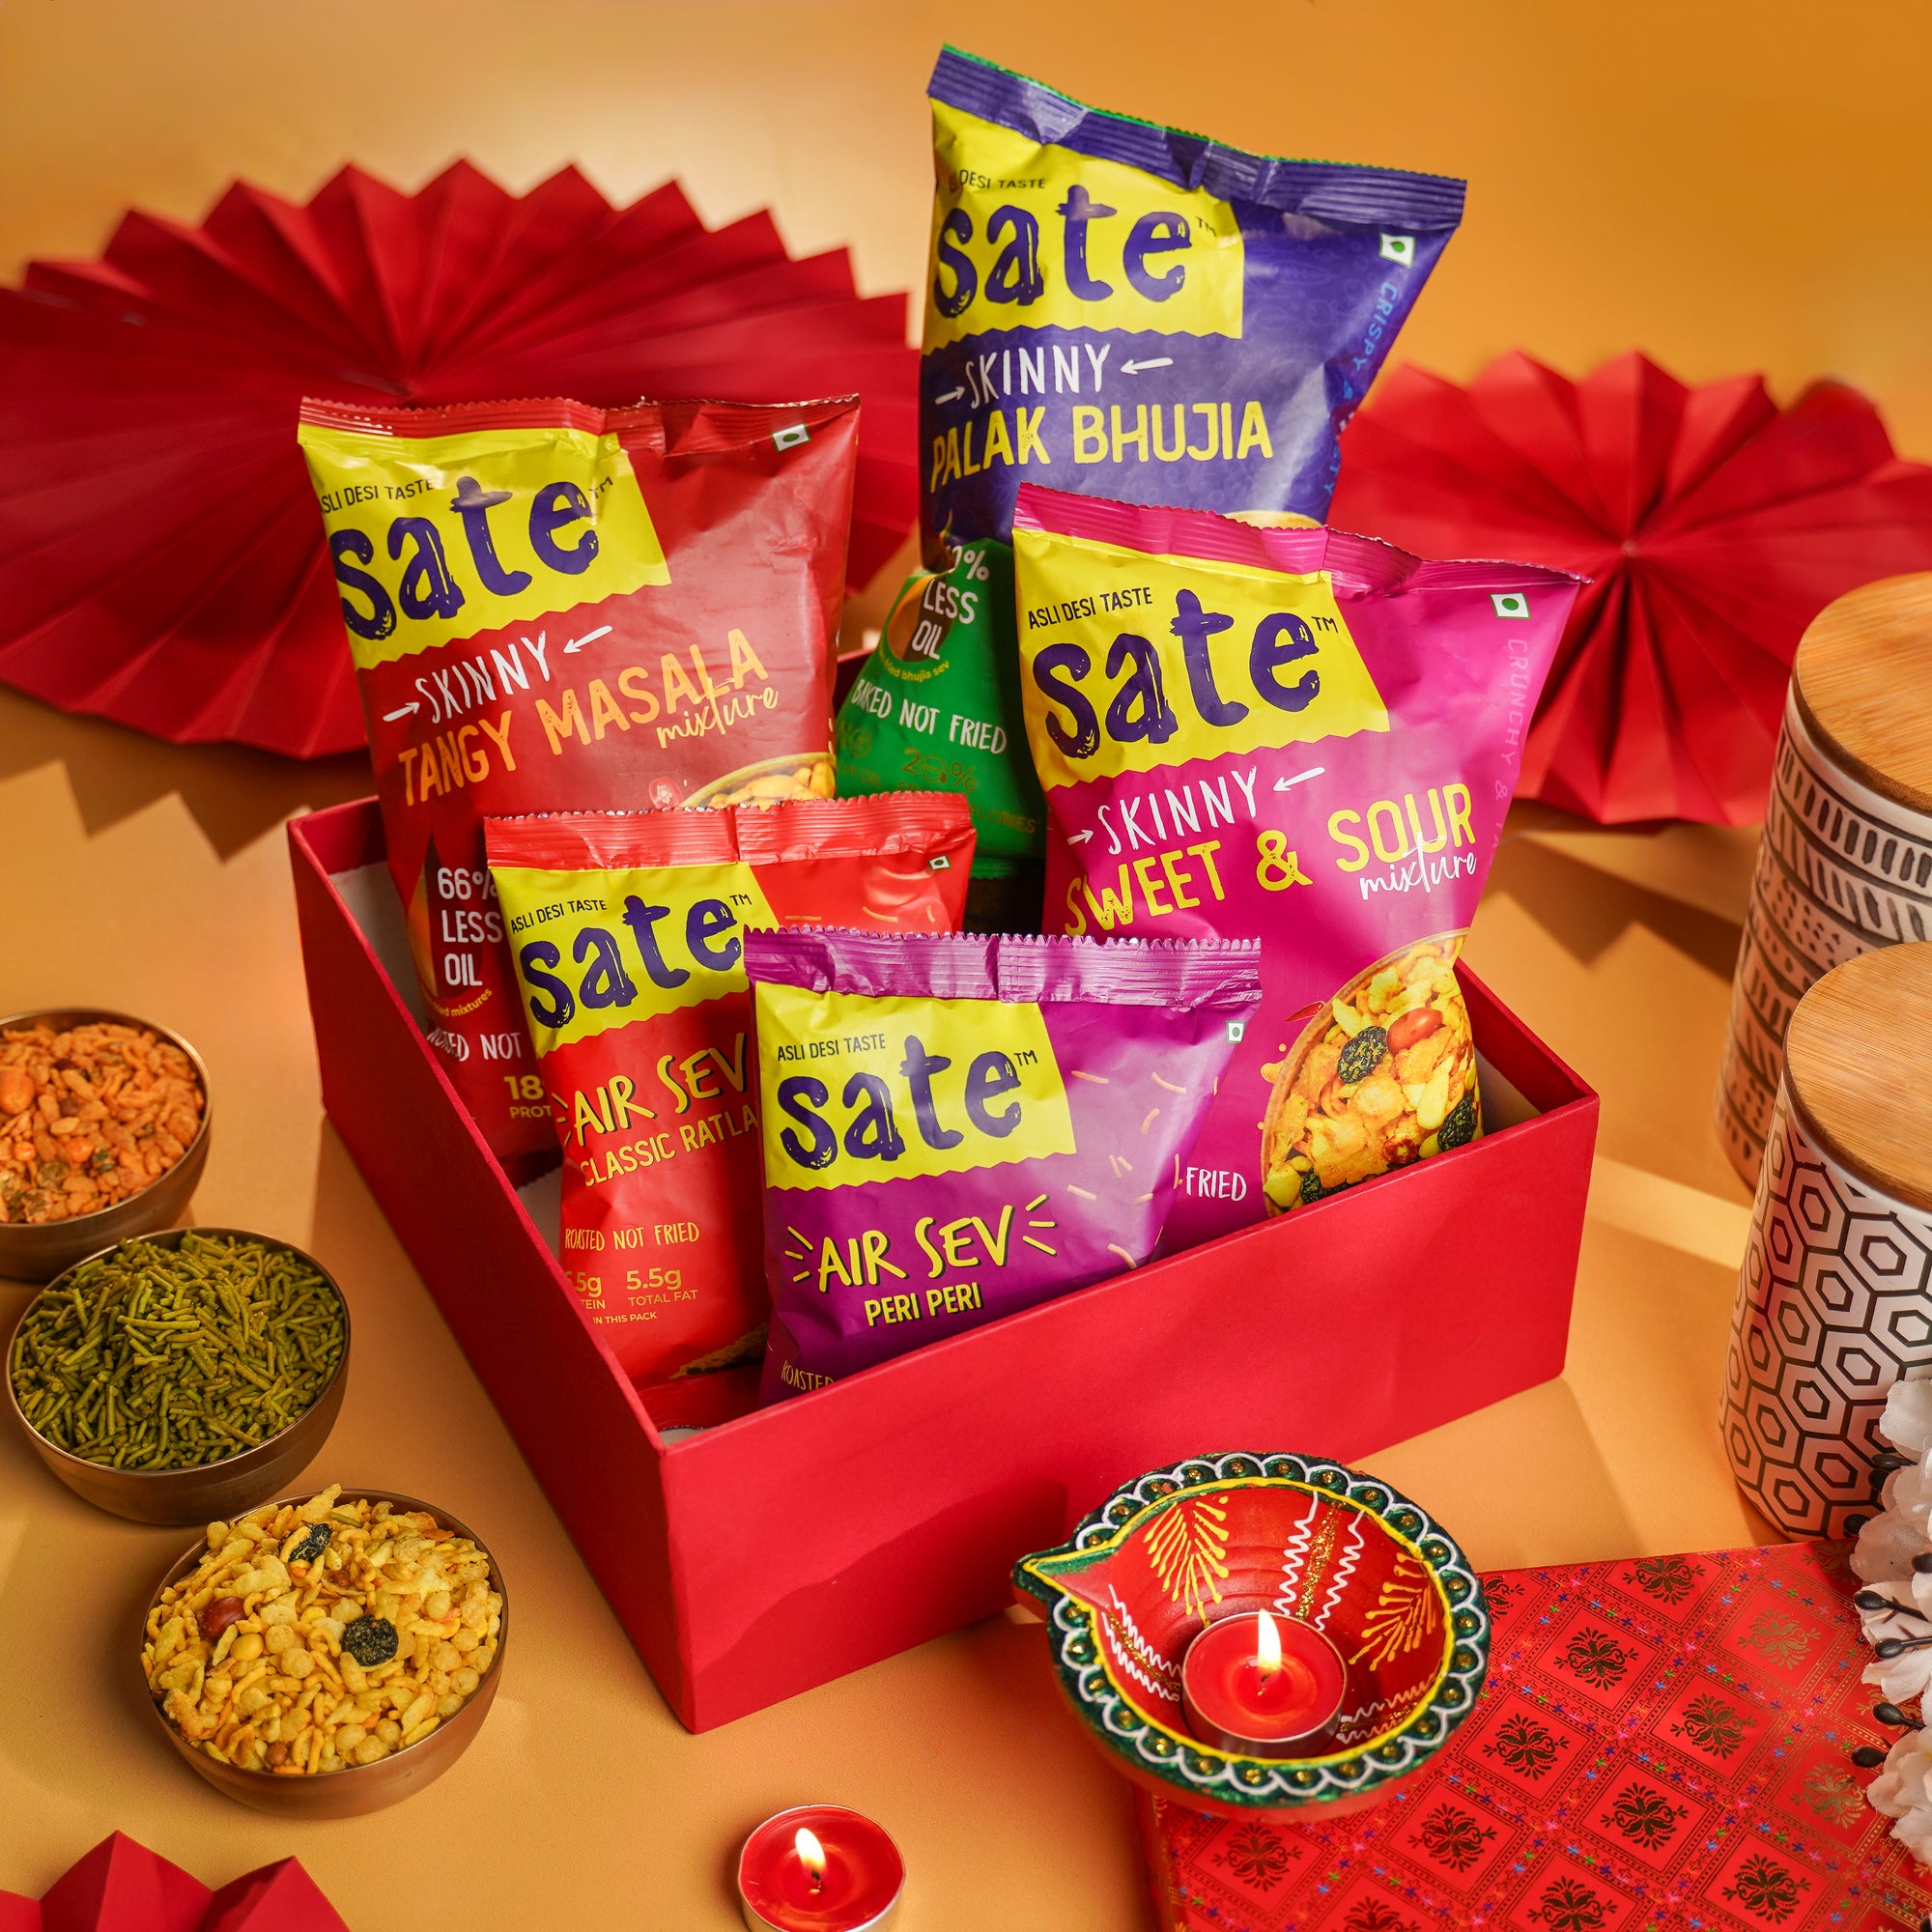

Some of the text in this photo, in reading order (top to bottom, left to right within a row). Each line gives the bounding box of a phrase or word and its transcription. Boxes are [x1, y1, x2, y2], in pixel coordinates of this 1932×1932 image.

[959, 169, 991, 189] DESI
[998, 178, 1046, 189] TASTE
[933, 185, 1193, 319] sate
[1352, 281, 1398, 371] CRISPY
[967, 343, 1111, 410] SKINNY
[930, 400, 1274, 494] PALAK BHUJIA
[322, 478, 434, 515] SLI DESI TASTE
[329, 475, 599, 641] sate
[923, 579, 979, 624] LESS
[1027, 586, 1153, 631] ASLI DESI TASTE
[911, 620, 941, 661] OIL
[416, 630, 552, 725] SKINNY
[932, 661, 950, 676] sev
[1032, 588, 1320, 759] sate
[398, 627, 769, 808] TANGY MASALA
[657, 676, 779, 750] mixture
[899, 698, 940, 736] NOT
[949, 714, 1007, 754] FRIED
[1500, 639, 1528, 766] CRUNCHY
[1097, 765, 1259, 855] SKINNY
[438, 867, 497, 900] 66%
[1064, 838, 1228, 938] SWEET
[1255, 828, 1314, 893] &
[1326, 782, 1477, 873] SOUR
[1358, 832, 1478, 900] mixture
[441, 910, 502, 943] LESS
[510, 898, 608, 935] ASLI DESI TASTE
[444, 953, 483, 986] OIL
[520, 895, 742, 1029] sate
[450, 988, 493, 1017] mixtures
[480, 1033, 522, 1061] NOT
[777, 1033, 887, 1062] ASLI DESI TASTE
[573, 1032, 749, 1149] AIR SEV
[777, 1035, 1022, 1170] sate
[580, 1132, 676, 1187] CLASSIC
[1186, 1166, 1247, 1202] FRIED
[565, 1221, 700, 1252] ROASTED NOT FRIED
[818, 1204, 1014, 1293] AIR SEV
[626, 1267, 682, 1292] 5.5g
[628, 1293, 671, 1307] TOTAL
[674, 1290, 698, 1302] FAT
[865, 1281, 983, 1327] PERI PERI
[605, 1314, 628, 1323] THIS
[630, 1311, 658, 1322] PACK
